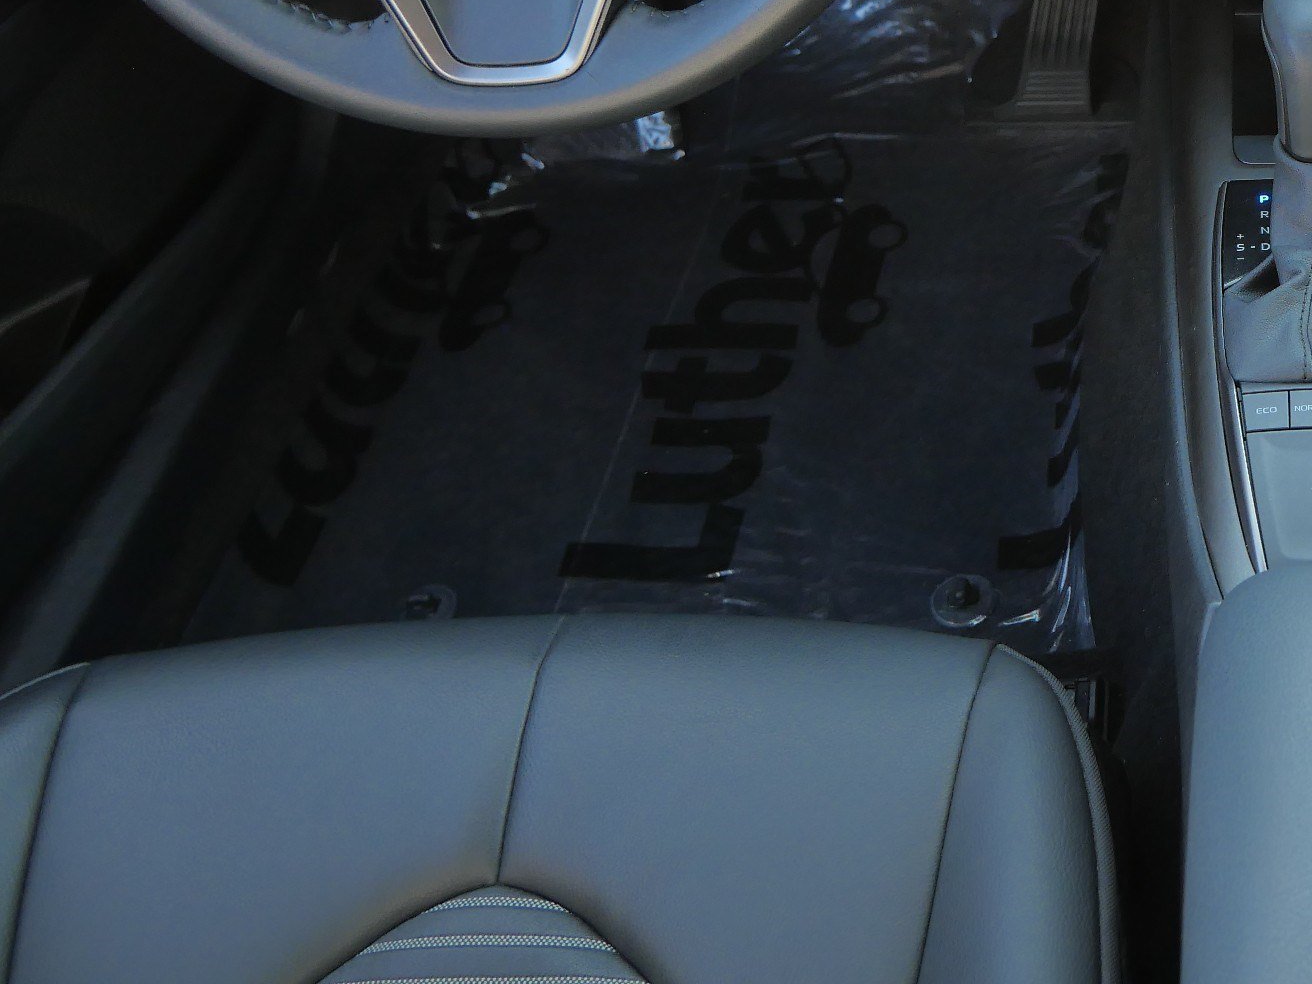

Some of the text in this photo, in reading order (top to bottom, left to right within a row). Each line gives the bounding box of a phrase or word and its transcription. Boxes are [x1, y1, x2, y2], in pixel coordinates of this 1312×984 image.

[1259, 194, 1270, 204] P
[1260, 210, 1270, 219] R
[1260, 226, 1270, 235] N
[1236, 242, 1246, 252] S
[1260, 242, 1271, 251] D
[556, 152, 838, 584] Luther
[1255, 406, 1278, 415] ECO
